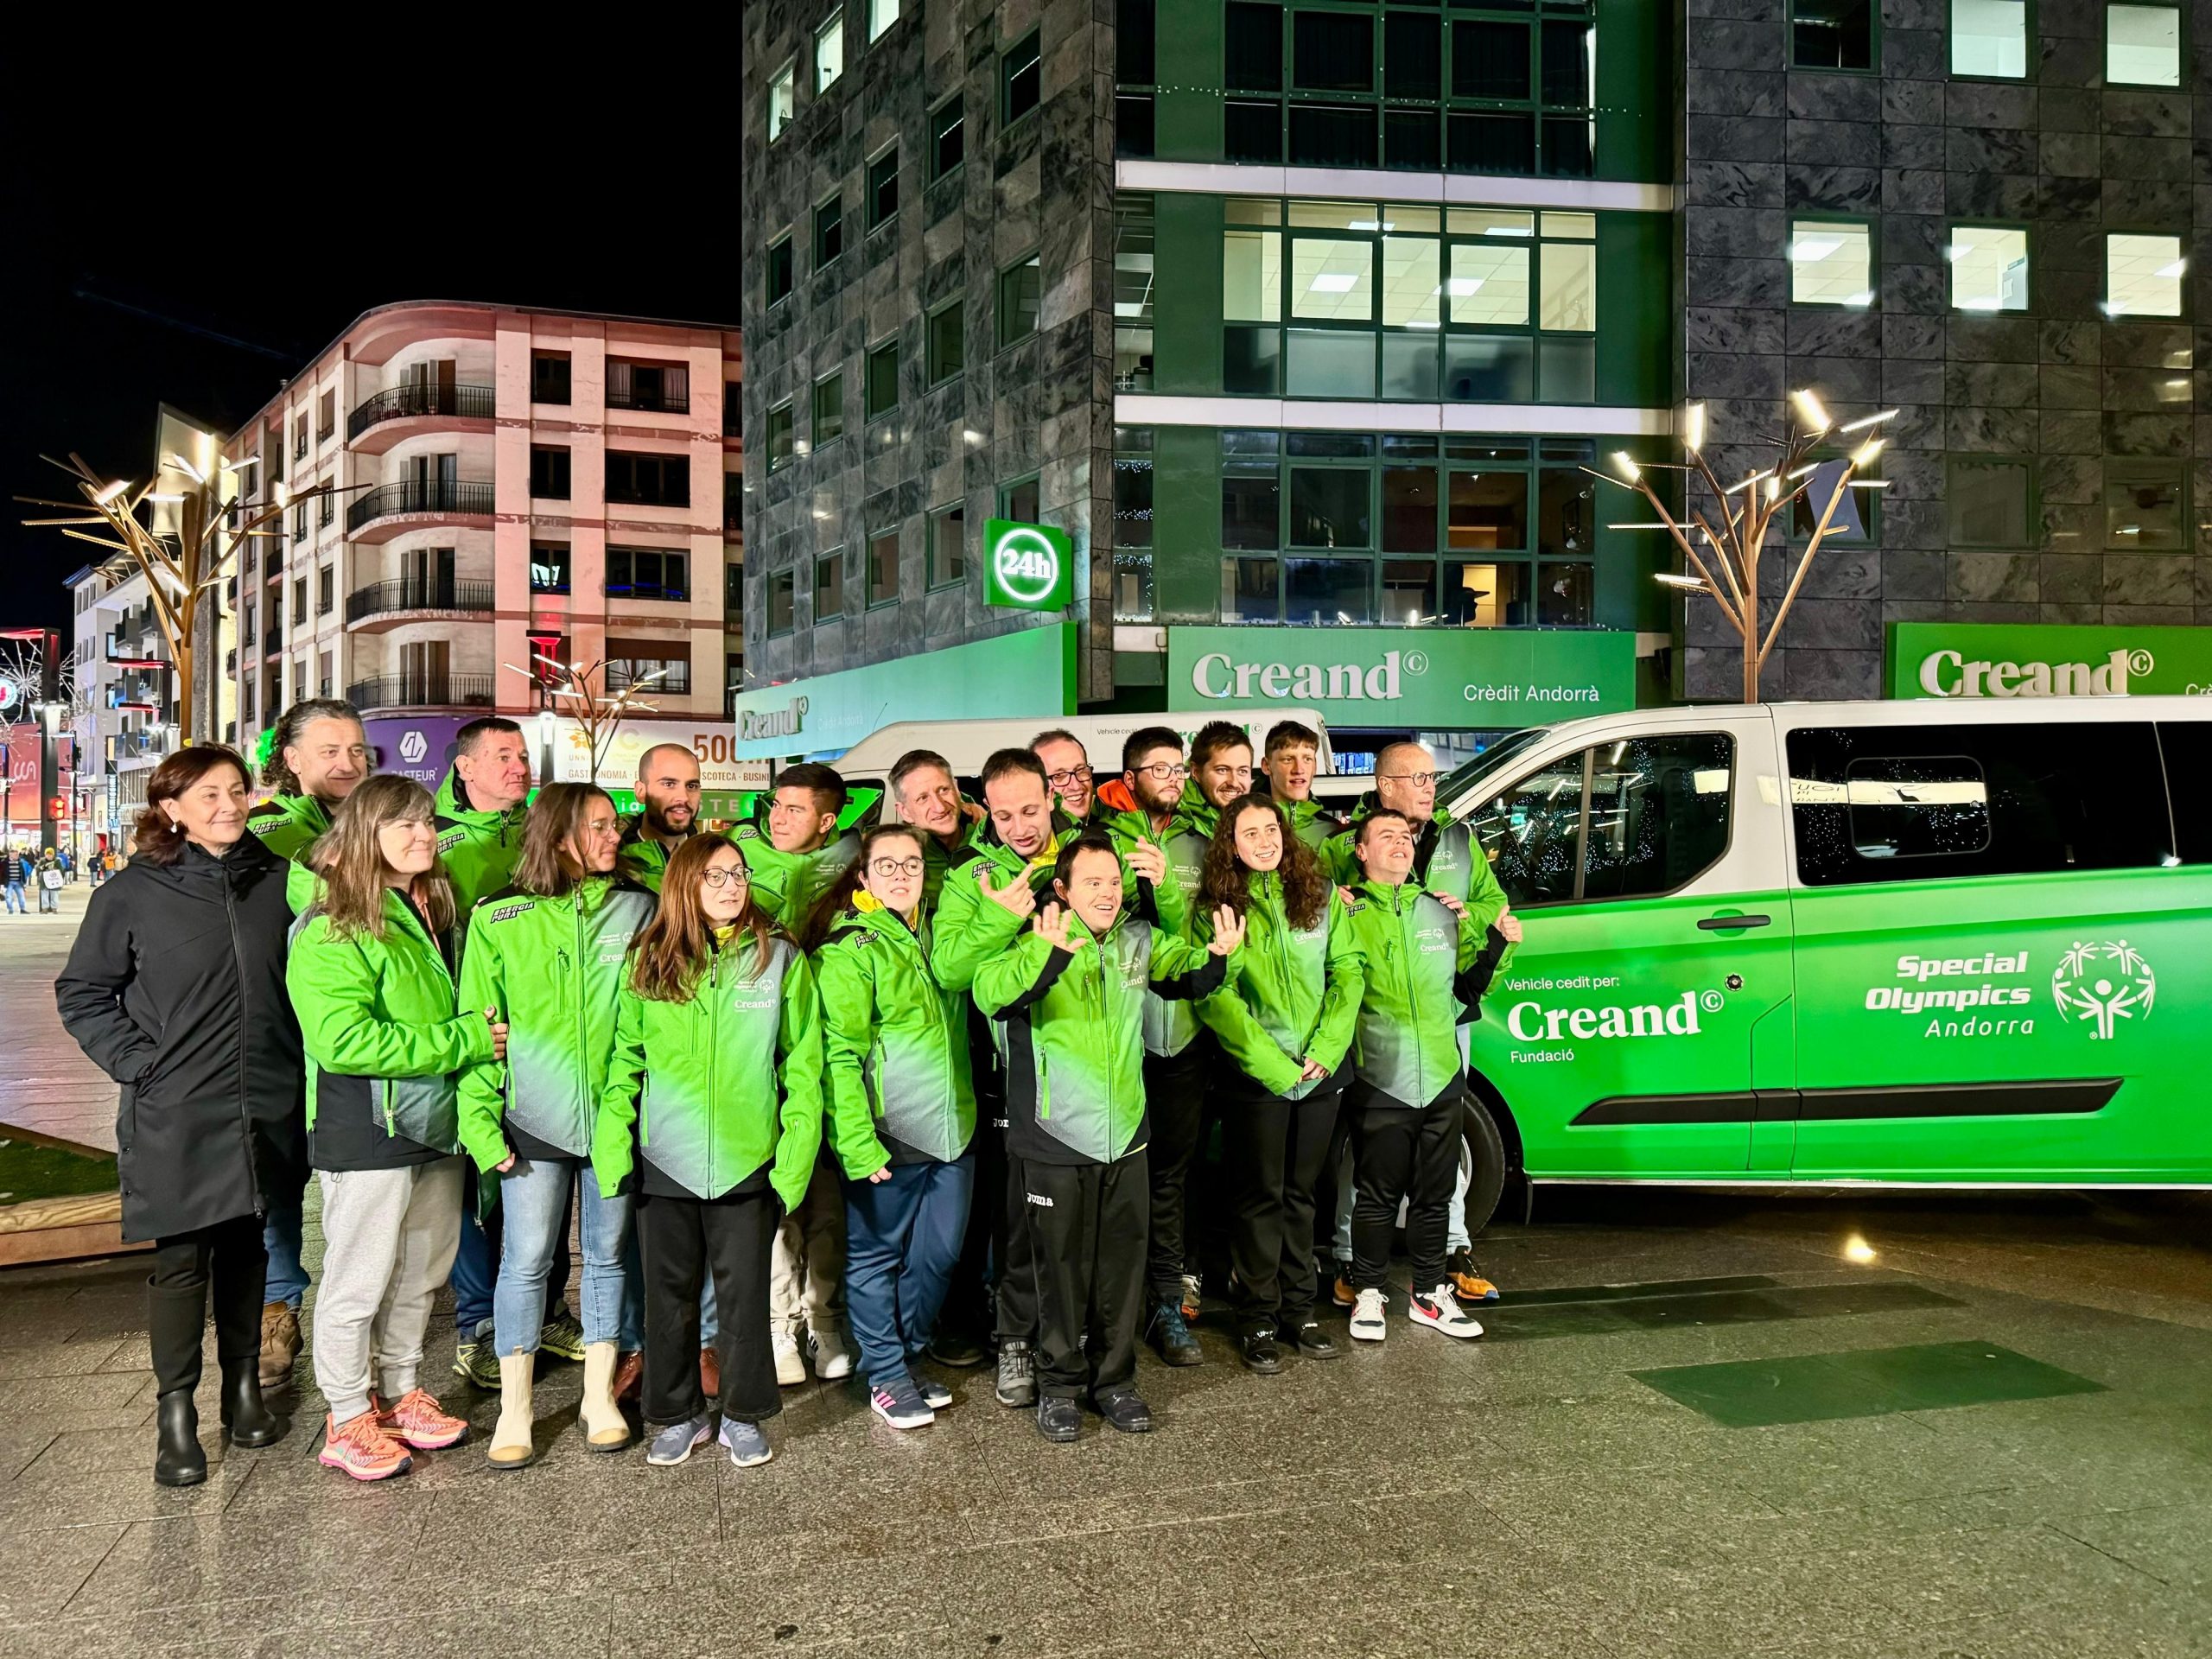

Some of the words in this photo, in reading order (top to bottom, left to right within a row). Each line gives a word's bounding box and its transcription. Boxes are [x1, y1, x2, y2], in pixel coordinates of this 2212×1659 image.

[1001, 549, 1052, 579] 24h
[1464, 684, 1520, 702] Crèdit
[1525, 685, 1600, 702] Andorrà
[2185, 683, 2212, 696] Crè
[569, 770, 627, 779] GASTONOMIA
[702, 772, 736, 781] SCOTECA
[437, 833, 465, 846] NERGIA
[437, 842, 454, 854] URA
[491, 911, 517, 923] PURA
[493, 902, 535, 917] ENERGIA
[1897, 951, 2029, 982] Special
[1504, 978, 1554, 991] Vehicle
[1556, 976, 1590, 989] cedit
[1593, 976, 1620, 990] per:
[1866, 984, 2031, 1014] Olympics
[1924, 1016, 2034, 1038] Andorra
[1510, 1049, 1574, 1064] Fundació
